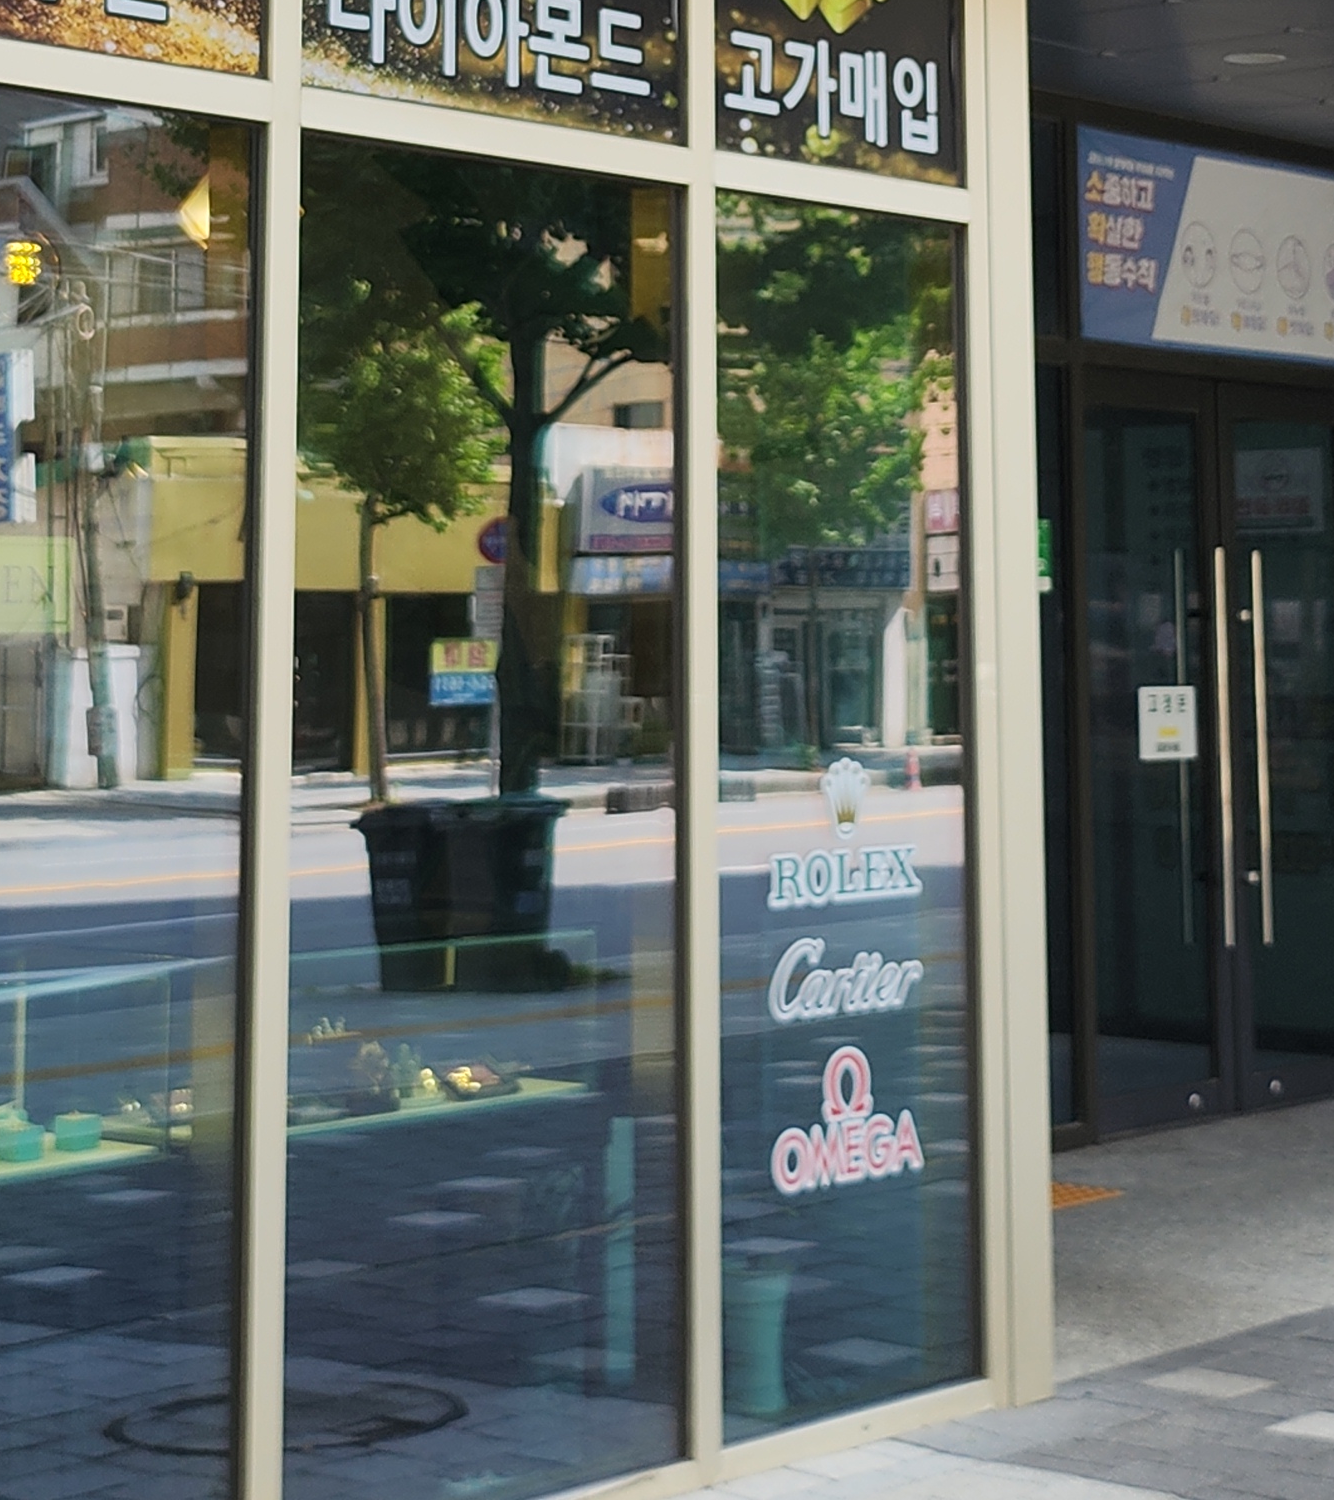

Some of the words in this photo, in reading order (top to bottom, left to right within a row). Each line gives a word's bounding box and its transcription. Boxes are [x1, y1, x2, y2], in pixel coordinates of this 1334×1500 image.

[723, 29, 939, 156] 고가매입
[772, 844, 922, 905] ROLEX
[769, 936, 924, 1024] Cartier
[770, 1108, 925, 1195] OMEGA
